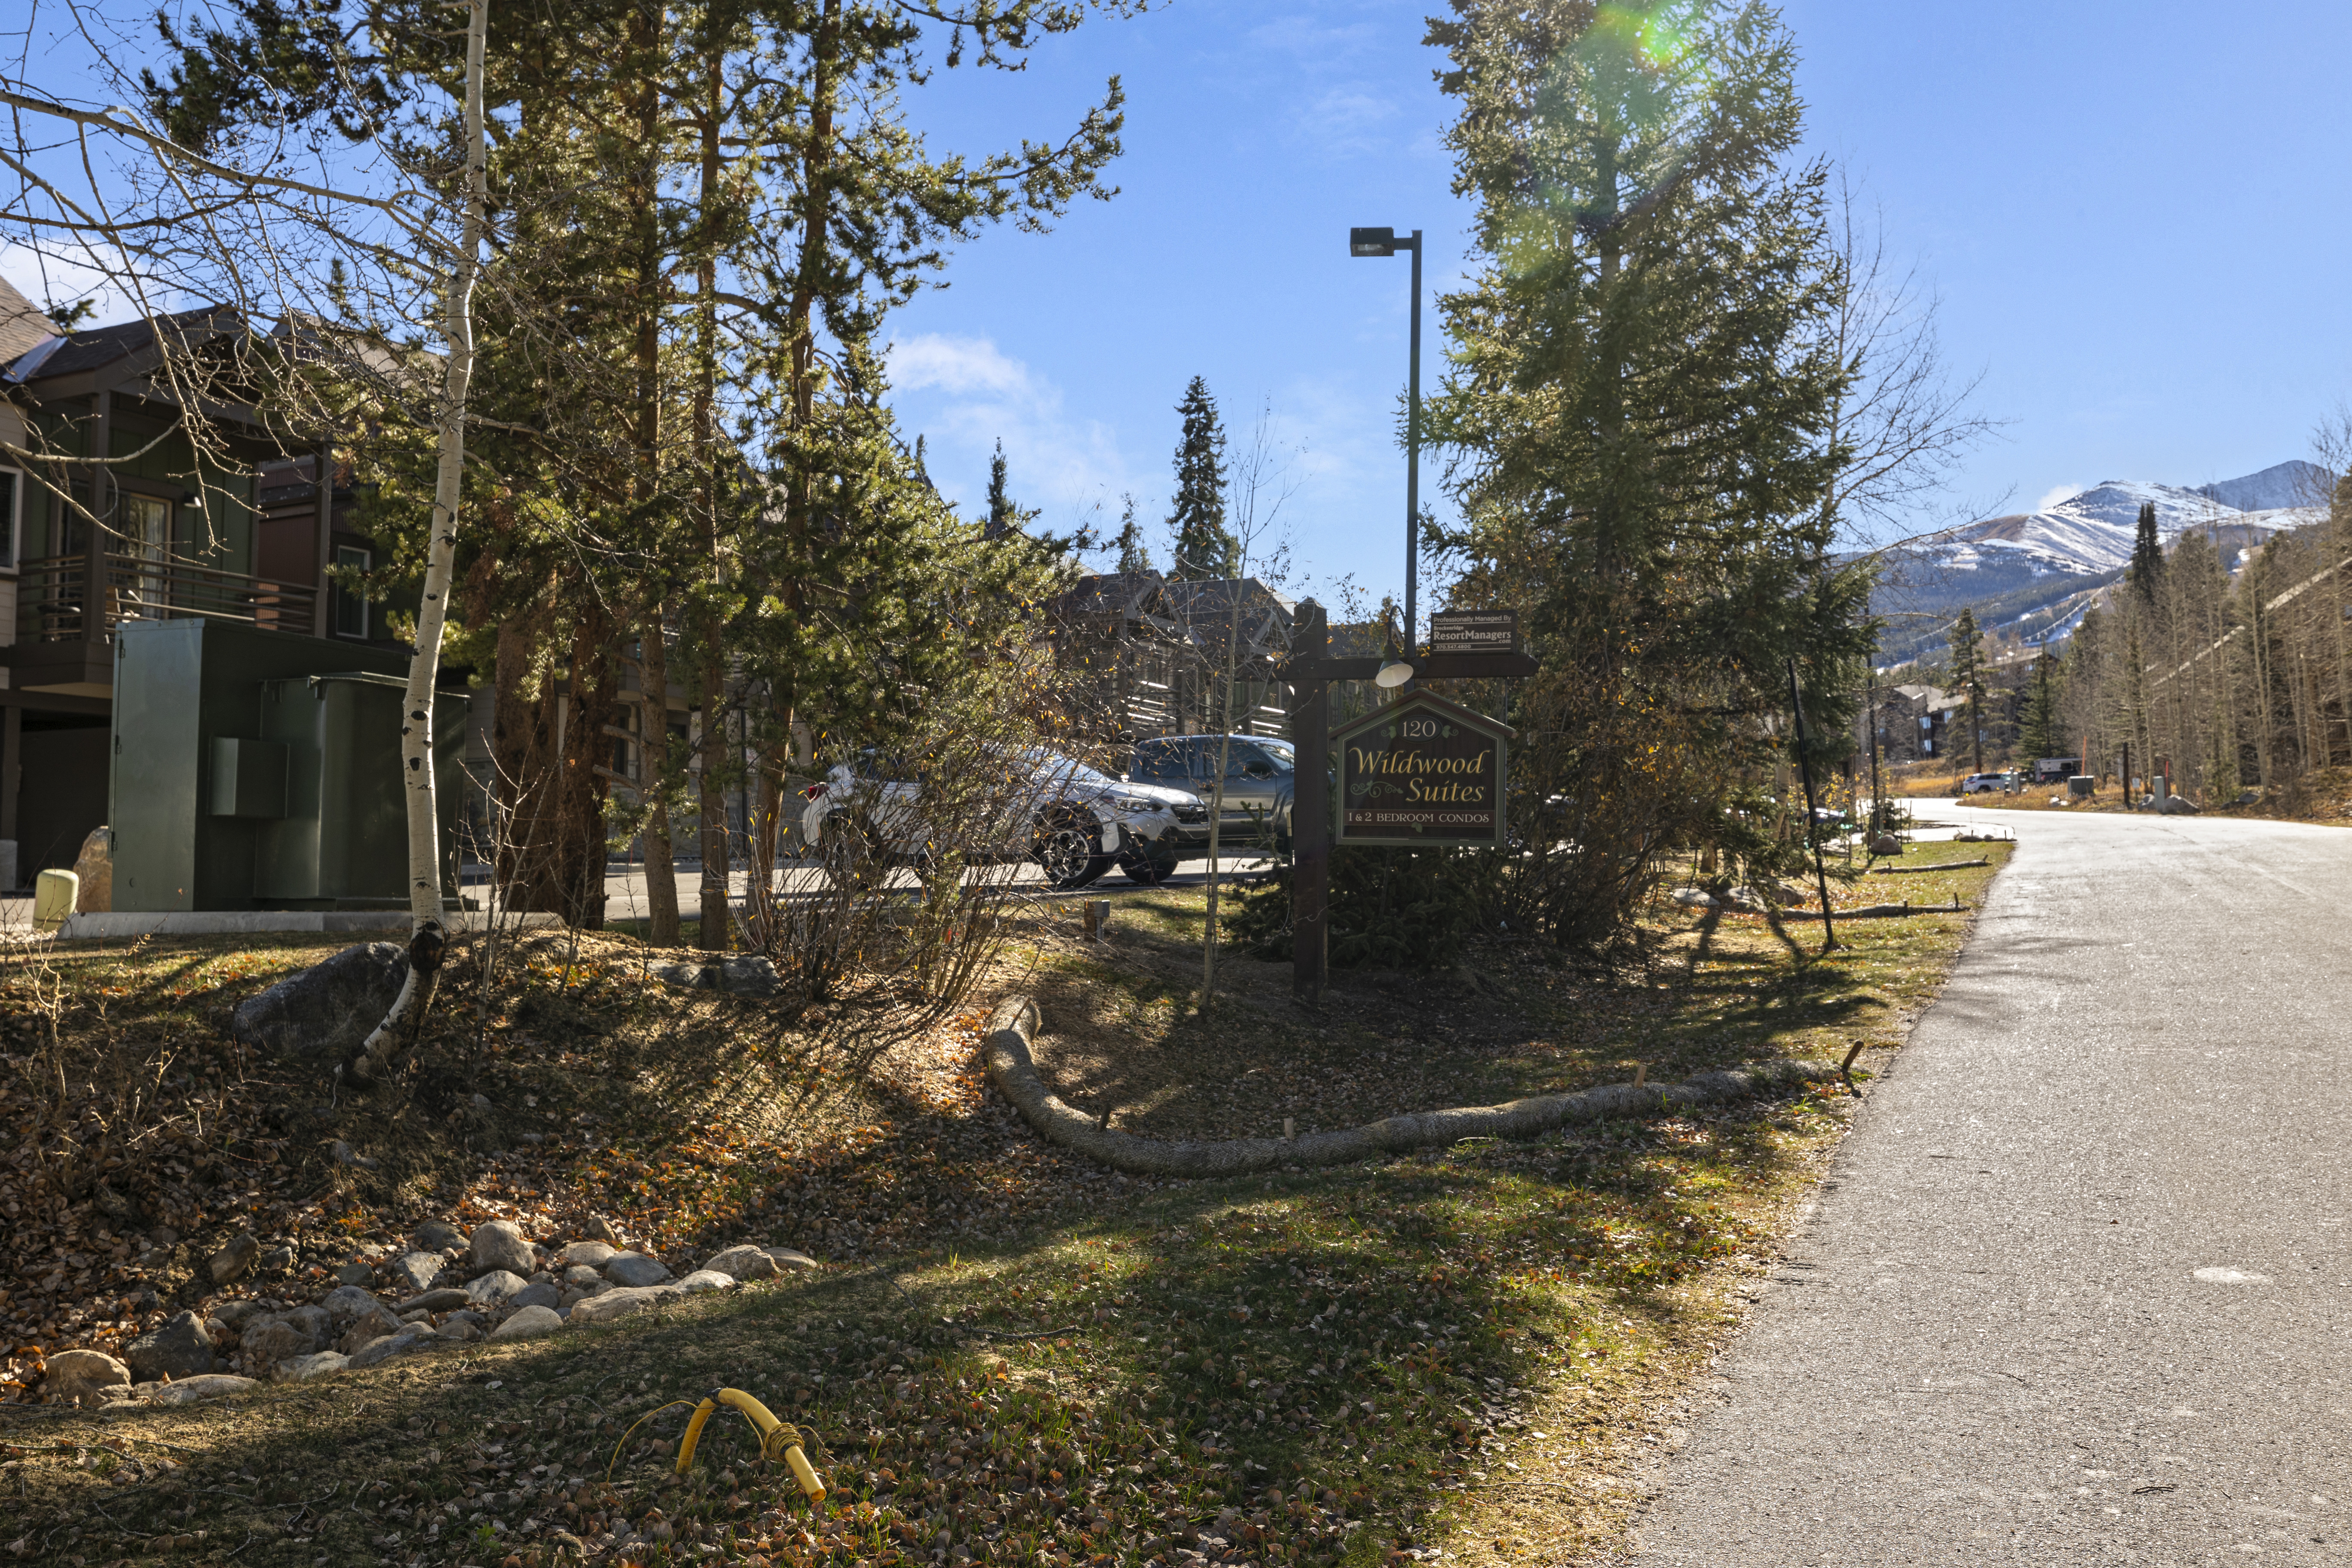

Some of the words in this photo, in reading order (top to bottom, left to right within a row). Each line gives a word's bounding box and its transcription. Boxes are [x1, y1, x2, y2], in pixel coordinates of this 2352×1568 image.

[1433, 630, 1511, 640] ResortManagers
[1403, 720, 1436, 737] 120
[1348, 747, 1491, 774] Wildwood
[1405, 778, 1484, 802] Suites
[1349, 812, 1352, 821] 1
[1365, 812, 1372, 821] 2
[1377, 813, 1434, 822] BEDROOM
[1439, 814, 1489, 823] CONDOS
